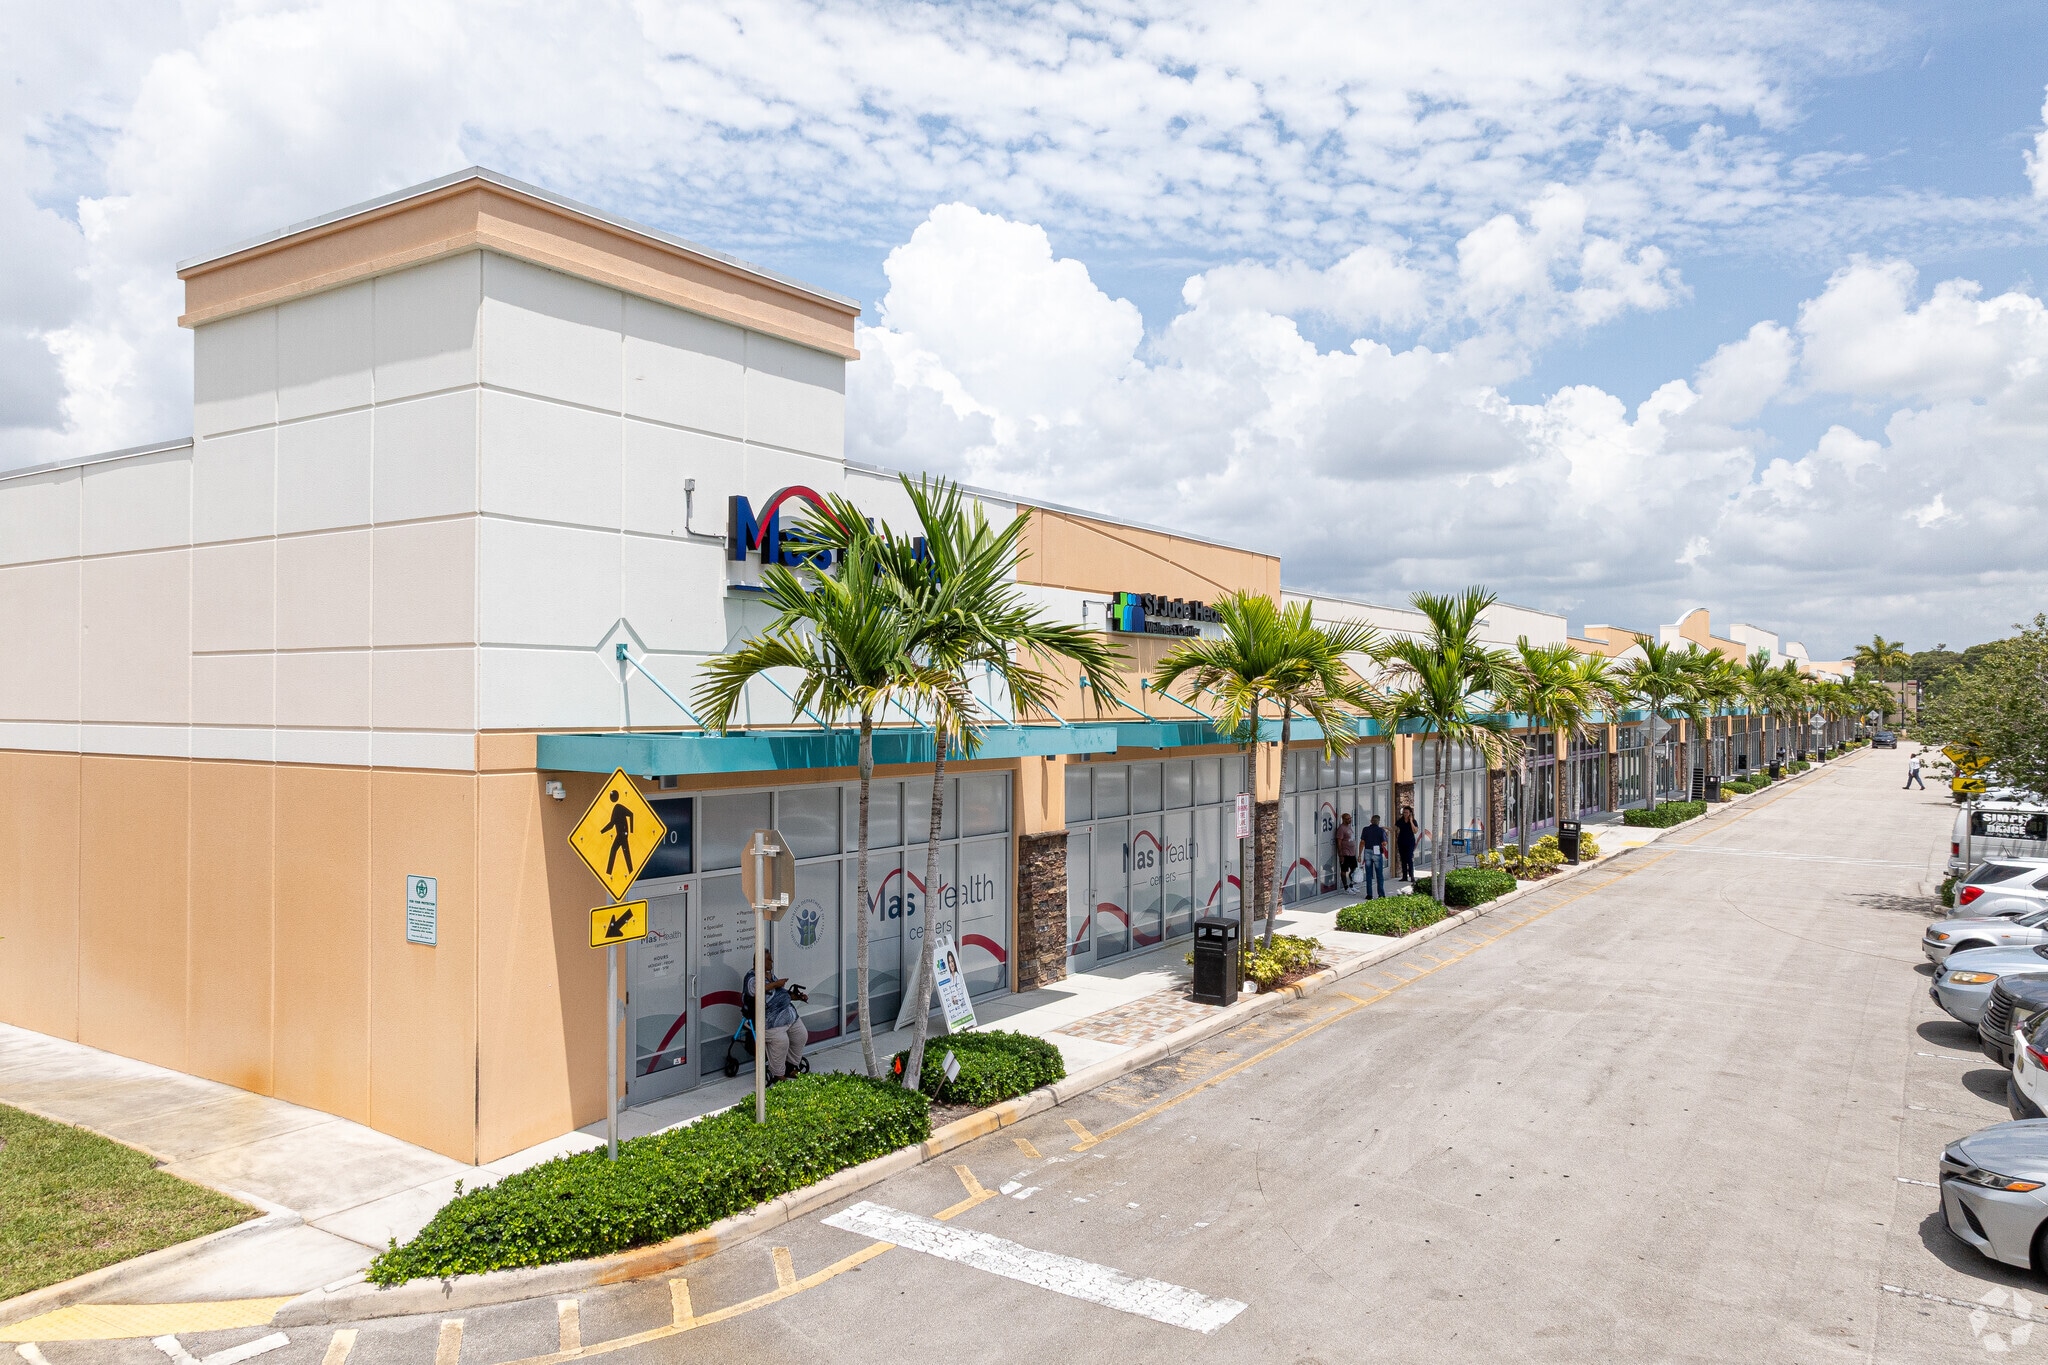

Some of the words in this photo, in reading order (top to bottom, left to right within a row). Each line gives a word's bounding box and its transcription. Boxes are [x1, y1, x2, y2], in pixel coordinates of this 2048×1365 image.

[728, 488, 833, 570] Mas
[1159, 595, 1191, 620] Jude
[1145, 621, 1177, 635] Wellness
[1177, 626, 1201, 637] Center
[1986, 824, 2026, 835] DANCE
[1122, 832, 1155, 873] Mas
[1149, 872, 1177, 887] ceners
[866, 872, 916, 921] Mas
[909, 920, 953, 940] ceers
